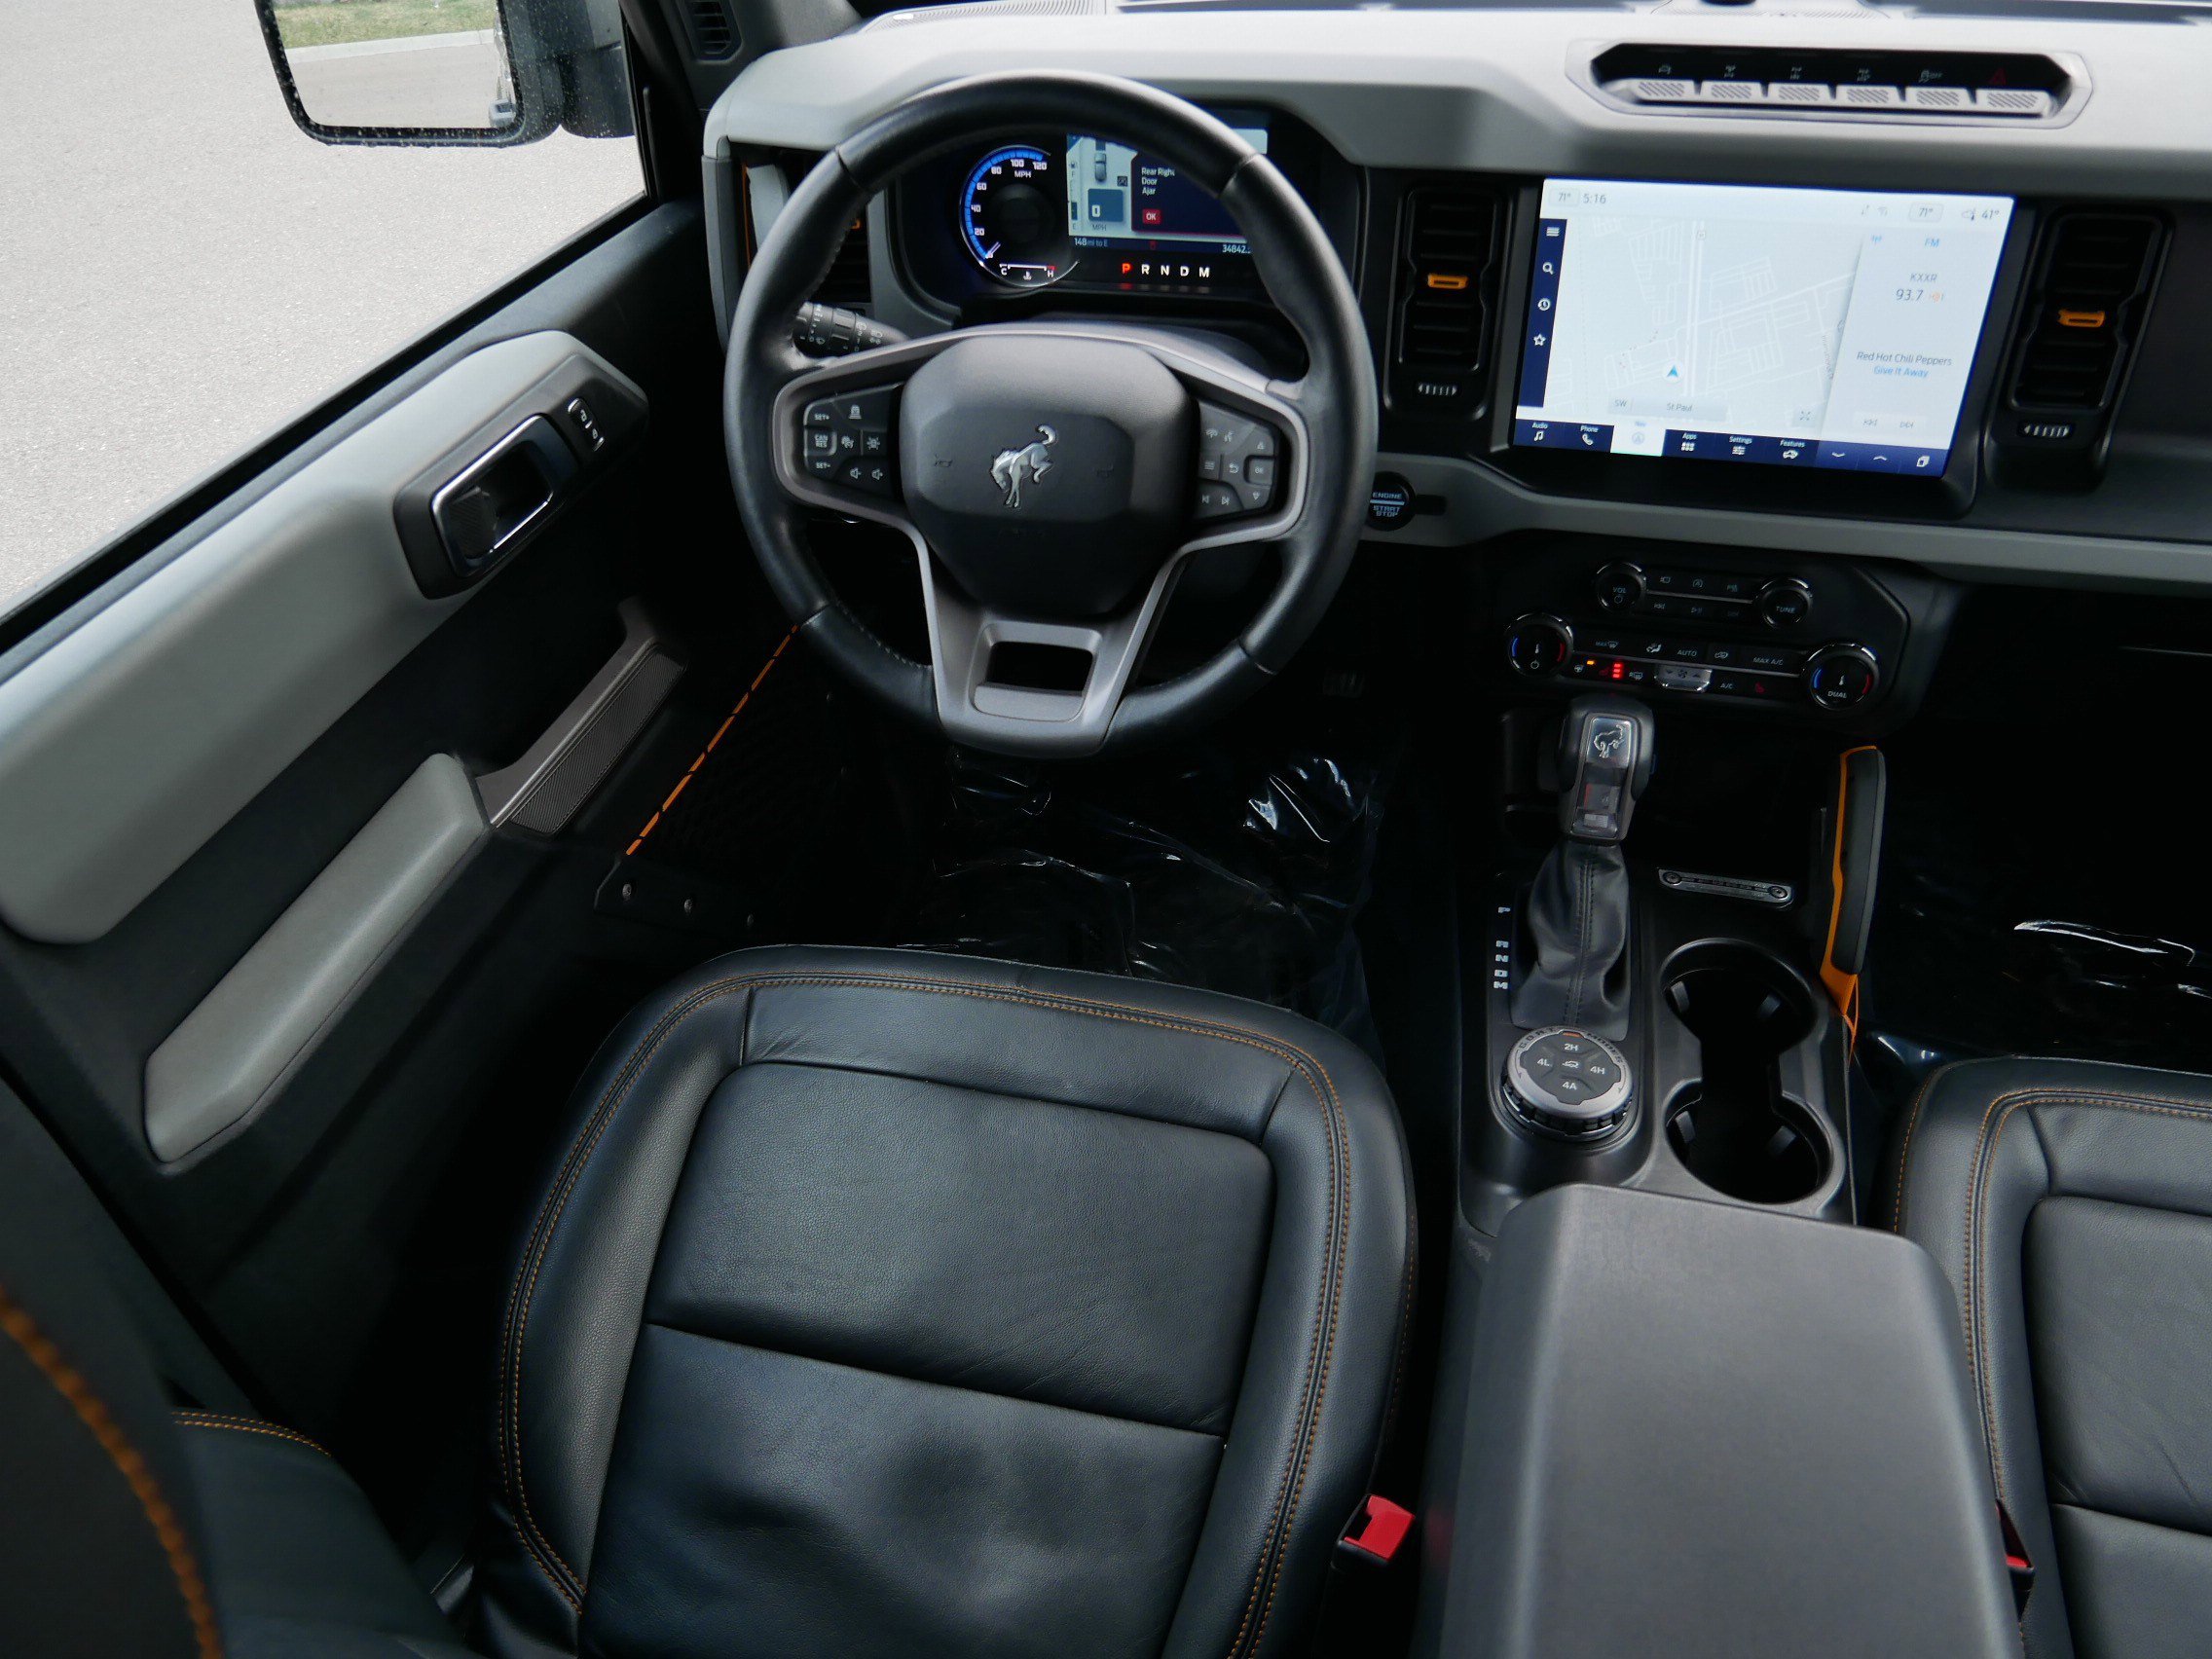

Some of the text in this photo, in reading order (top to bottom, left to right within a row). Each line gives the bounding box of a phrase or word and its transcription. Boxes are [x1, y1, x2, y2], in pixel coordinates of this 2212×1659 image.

[1011, 159, 1024, 167] 100
[1033, 162, 1047, 170] 120
[1141, 166, 1157, 175] Rear
[977, 182, 987, 191] 60
[1142, 187, 1156, 196] Ajar
[1582, 193, 1606, 204] 5:16
[1091, 204, 1101, 217] 0
[1146, 212, 1157, 221] OK
[974, 227, 985, 236] 20
[1074, 238, 1088, 246] 148
[1924, 238, 1939, 247] FM
[1222, 243, 1251, 254] 34842.
[1000, 267, 1008, 276] C
[1047, 269, 1054, 277] H
[1122, 263, 1210, 277] P R N D M
[1896, 289, 1924, 301] 93.7
[1857, 351, 1952, 366] Red Hot Chili Peppers
[1873, 366, 1894, 375] Give
[1903, 369, 1929, 378] Away
[1580, 424, 1599, 433] Phone
[1681, 432, 1697, 441] Apps
[1729, 435, 1752, 445] Settings
[1780, 439, 1806, 448] Features
[1826, 690, 1848, 699] DUAL
[1494, 954, 1509, 963] N
[1493, 969, 1508, 977] D
[1493, 980, 1508, 990] M
[1564, 1043, 1578, 1051] 2H
[1536, 1057, 1551, 1067] 4L
[1590, 1065, 1605, 1075] 4H
[1562, 1081, 1577, 1090] 4A
